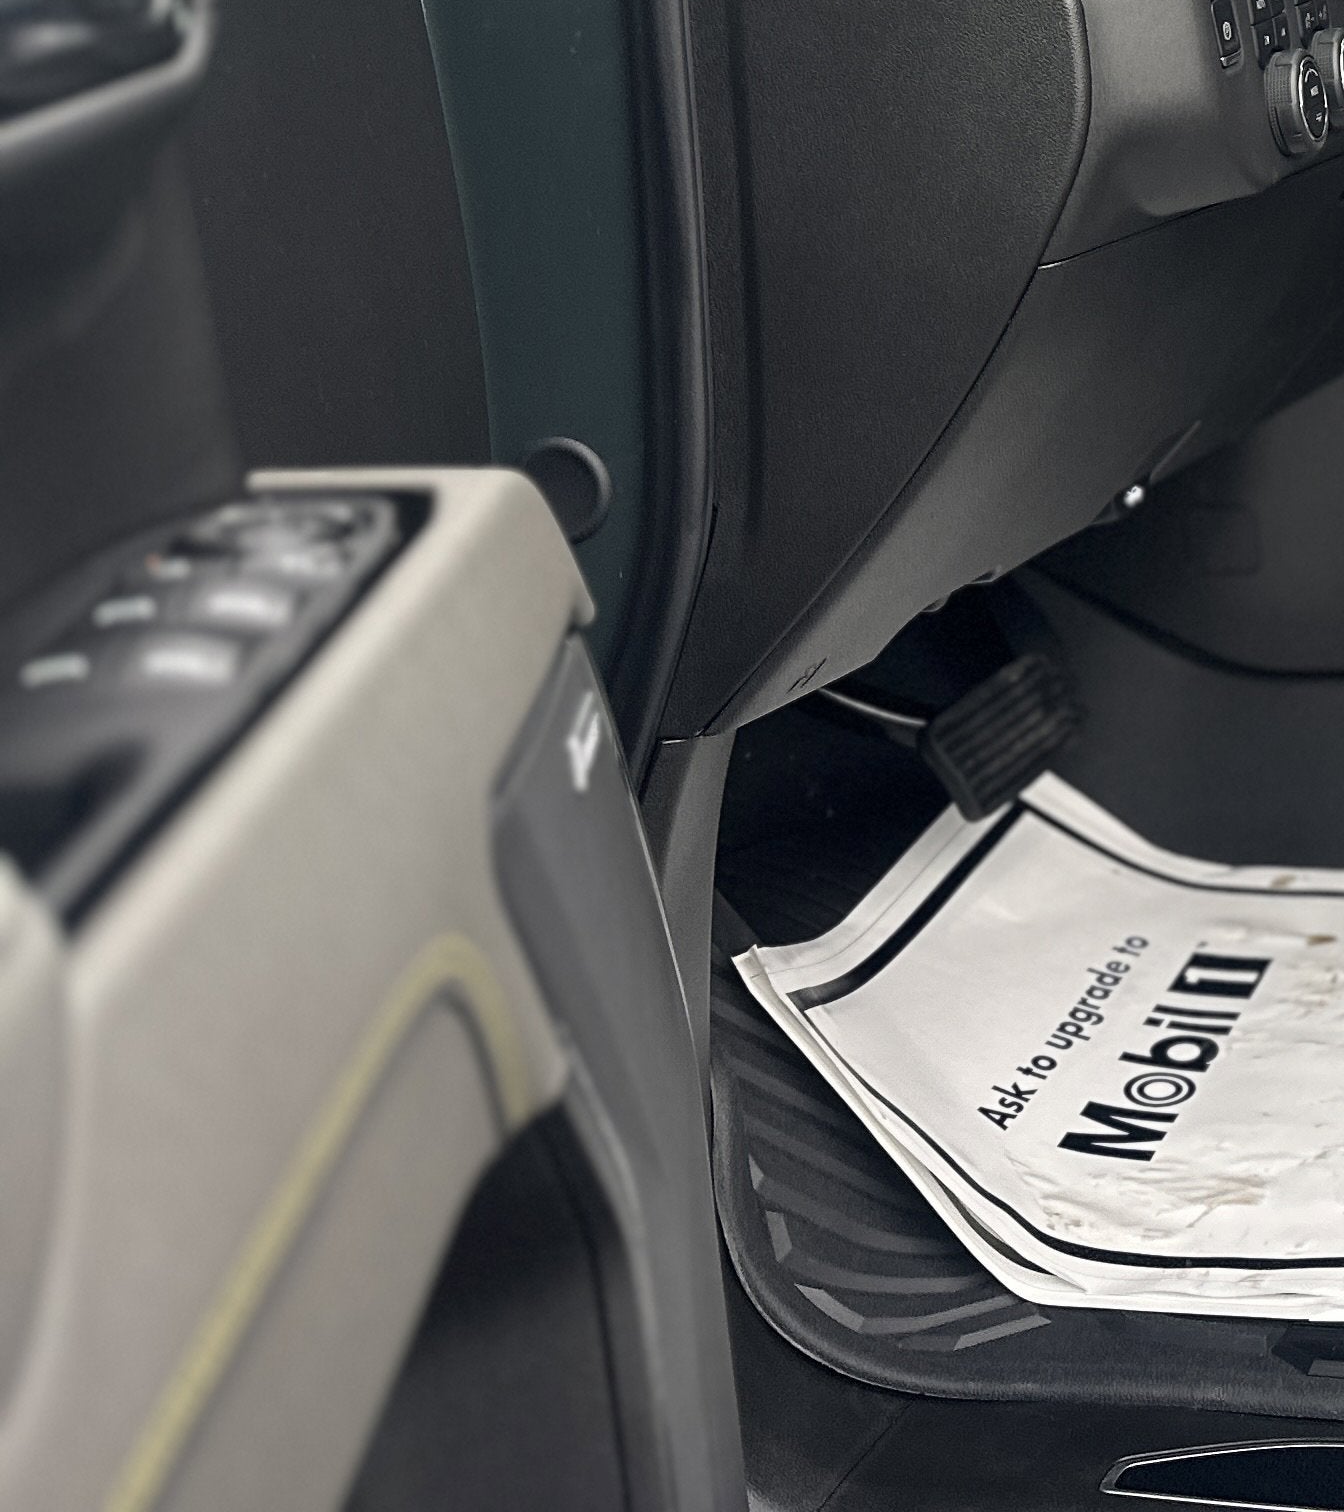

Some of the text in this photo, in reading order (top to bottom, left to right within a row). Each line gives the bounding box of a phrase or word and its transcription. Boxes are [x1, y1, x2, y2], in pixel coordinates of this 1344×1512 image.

[977, 935, 1150, 1131] Ask to upgrade to
[1057, 1003, 1242, 1162] Mobil
